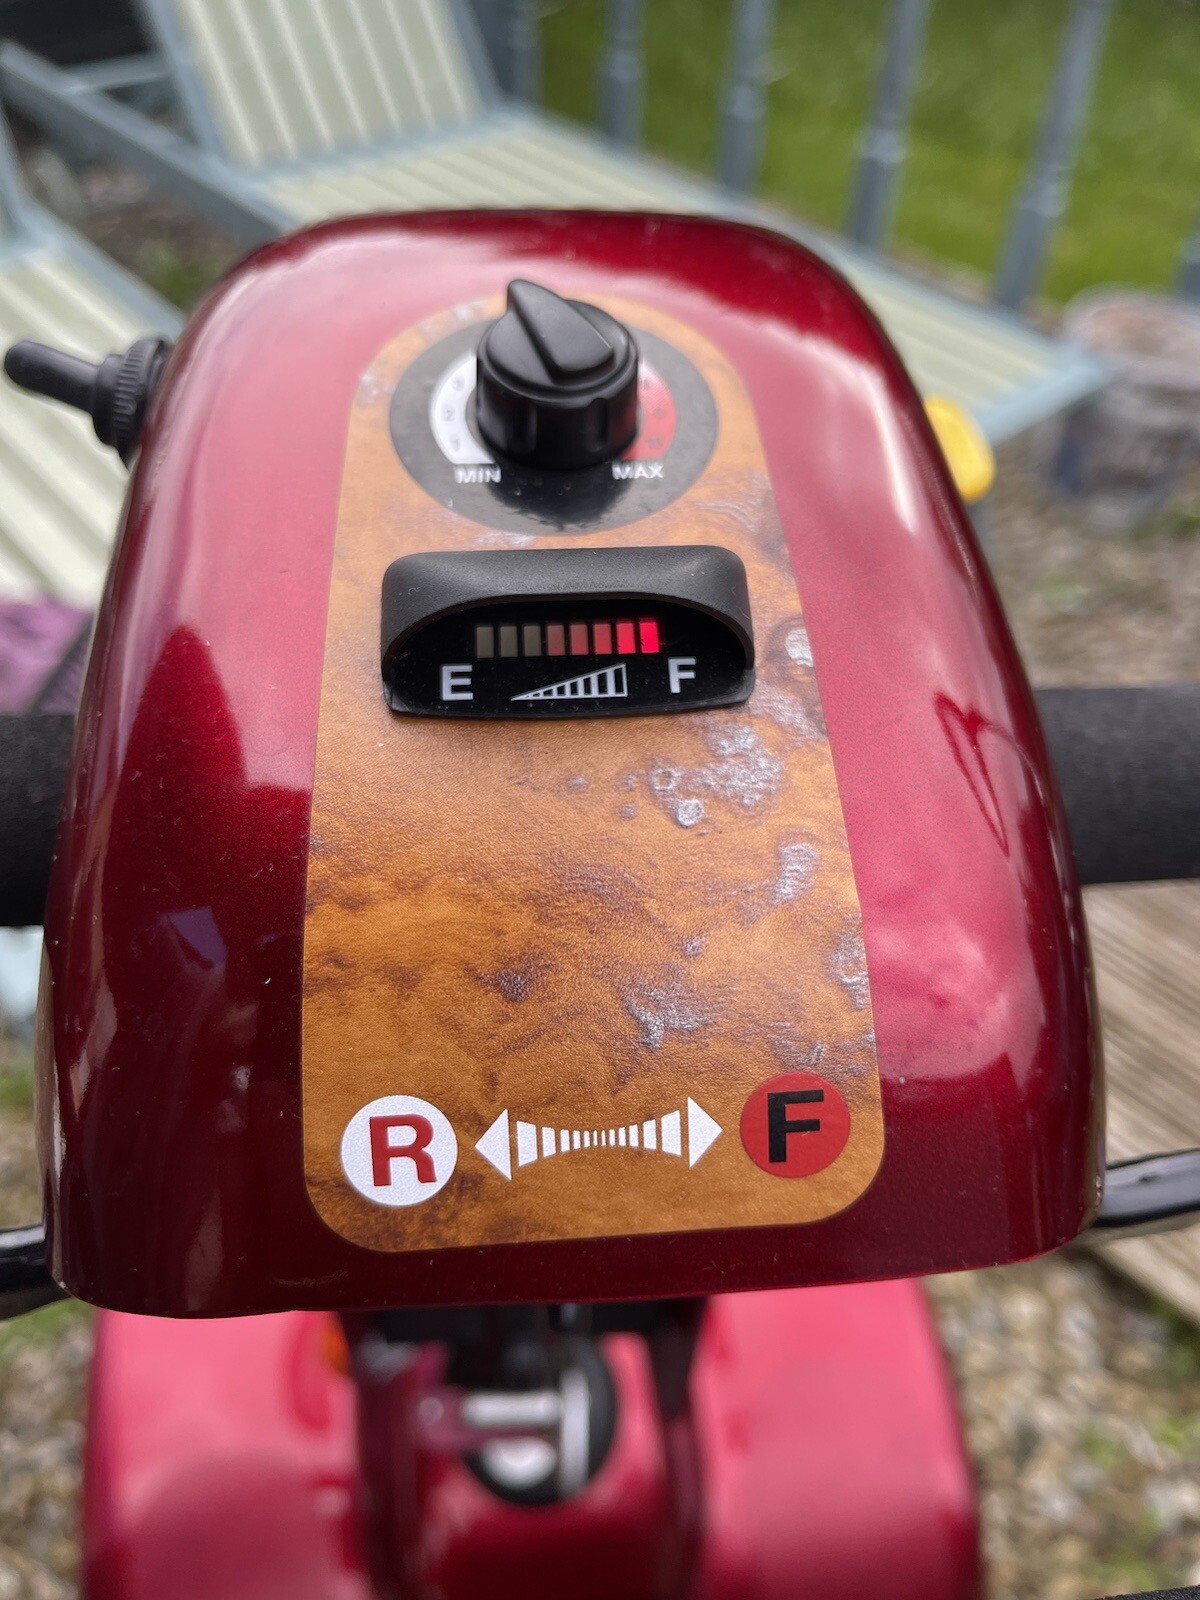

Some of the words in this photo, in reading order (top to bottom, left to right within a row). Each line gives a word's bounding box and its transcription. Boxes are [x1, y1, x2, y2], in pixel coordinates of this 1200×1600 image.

[442, 406, 456, 421] 2
[456, 466, 501, 483] MIN
[612, 462, 664, 480] MAX
[440, 663, 474, 700] E
[667, 656, 696, 693] F
[767, 1089, 824, 1163] F
[369, 1113, 437, 1187] R
